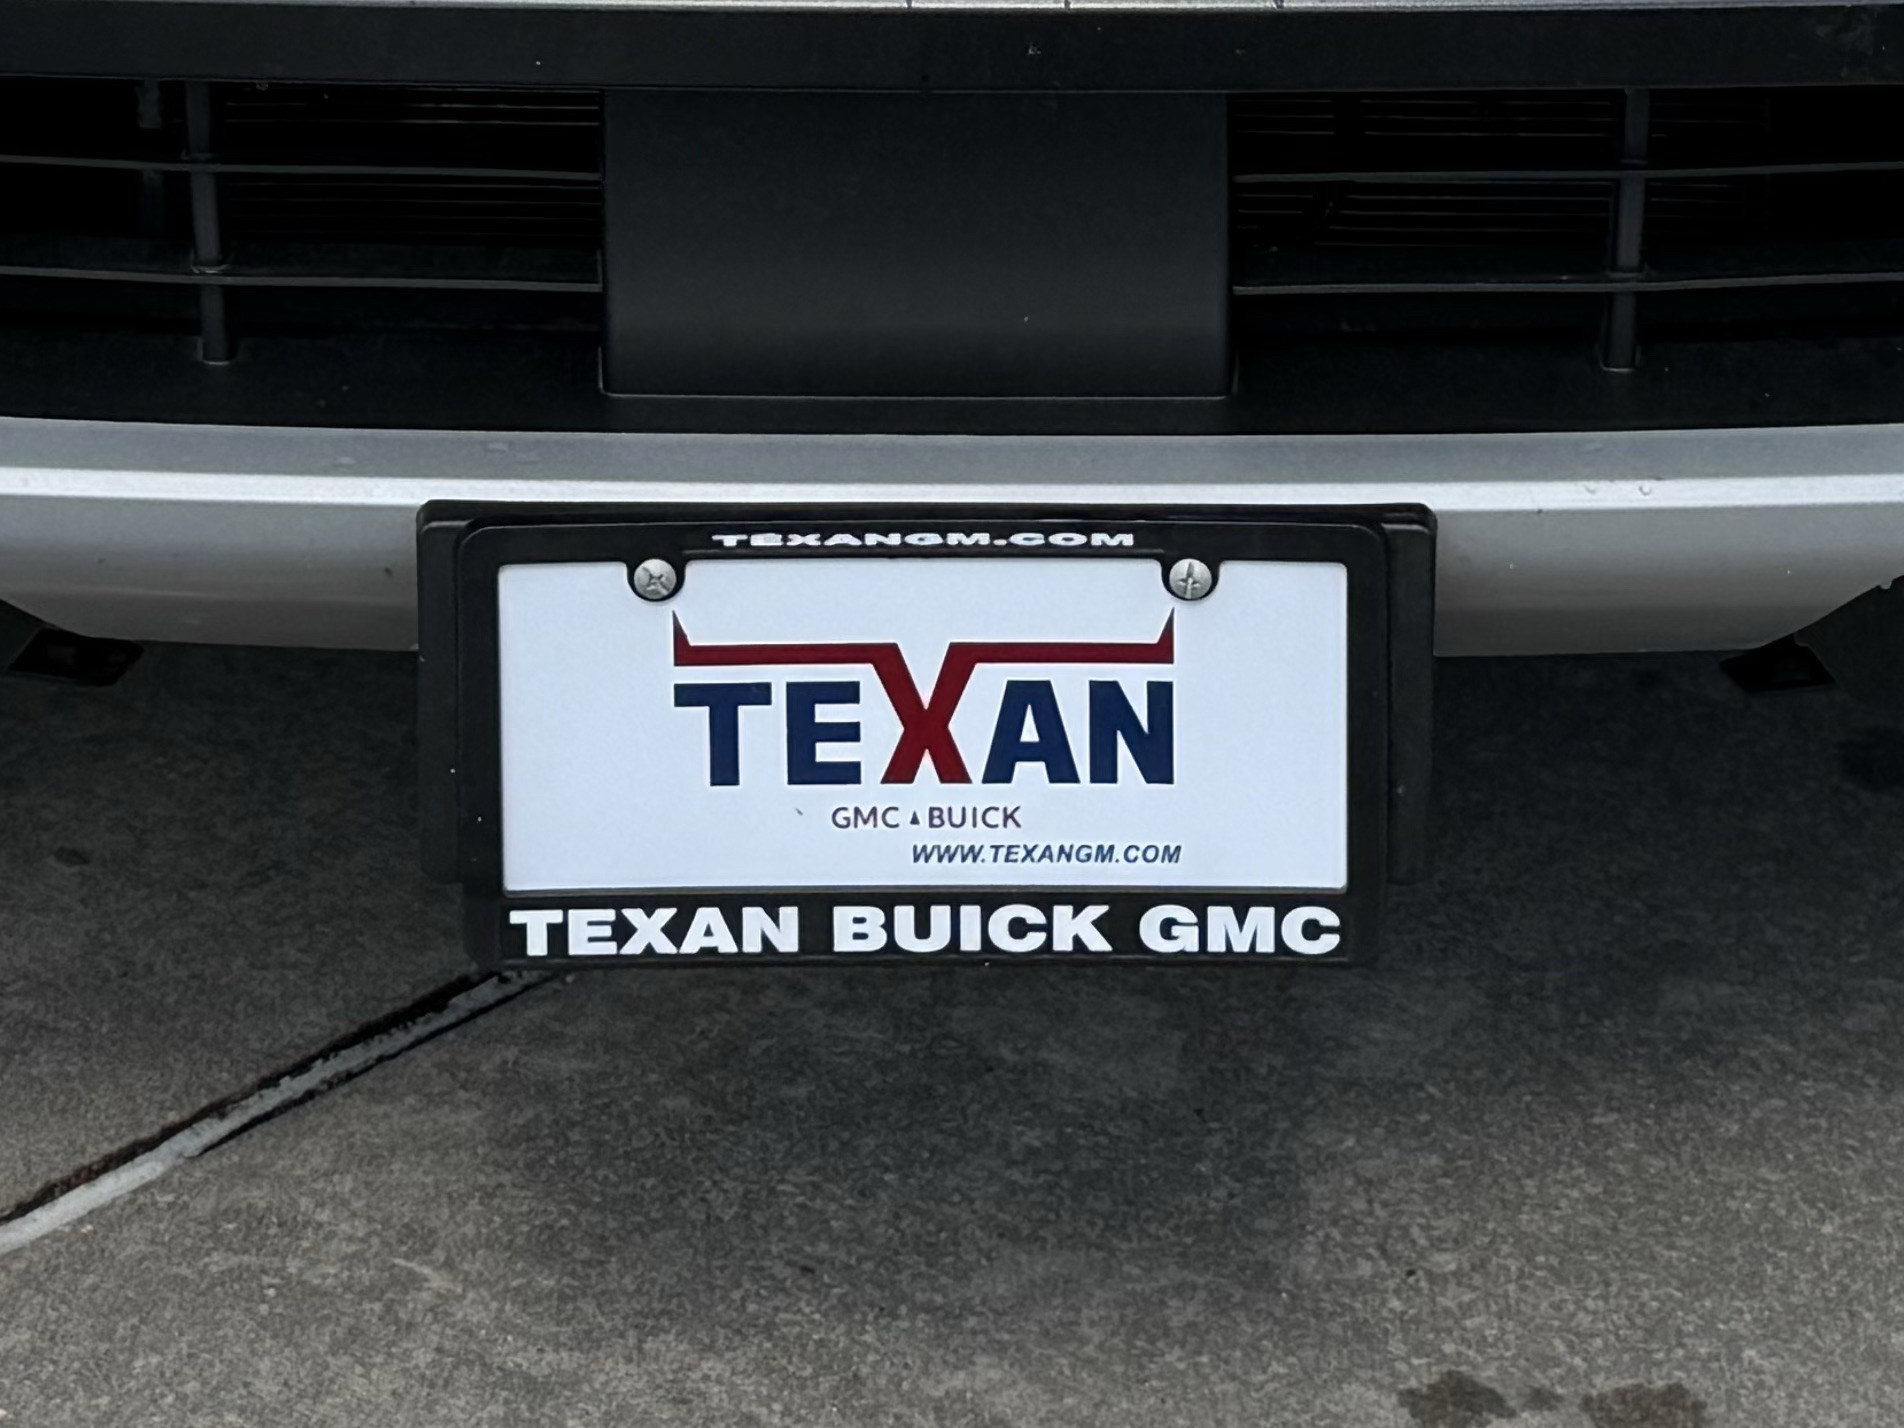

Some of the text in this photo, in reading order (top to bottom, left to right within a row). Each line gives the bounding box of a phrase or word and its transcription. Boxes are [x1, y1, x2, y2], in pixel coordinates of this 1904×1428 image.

[712, 532, 1134, 546] TEXANGM.COM
[673, 642, 1175, 787] TEXAN
[831, 806, 1022, 828] GMC BUICK
[911, 844, 1182, 864] WWW.TEXANGM.COM
[509, 906, 1342, 956] TEXAN BUICK GMC
